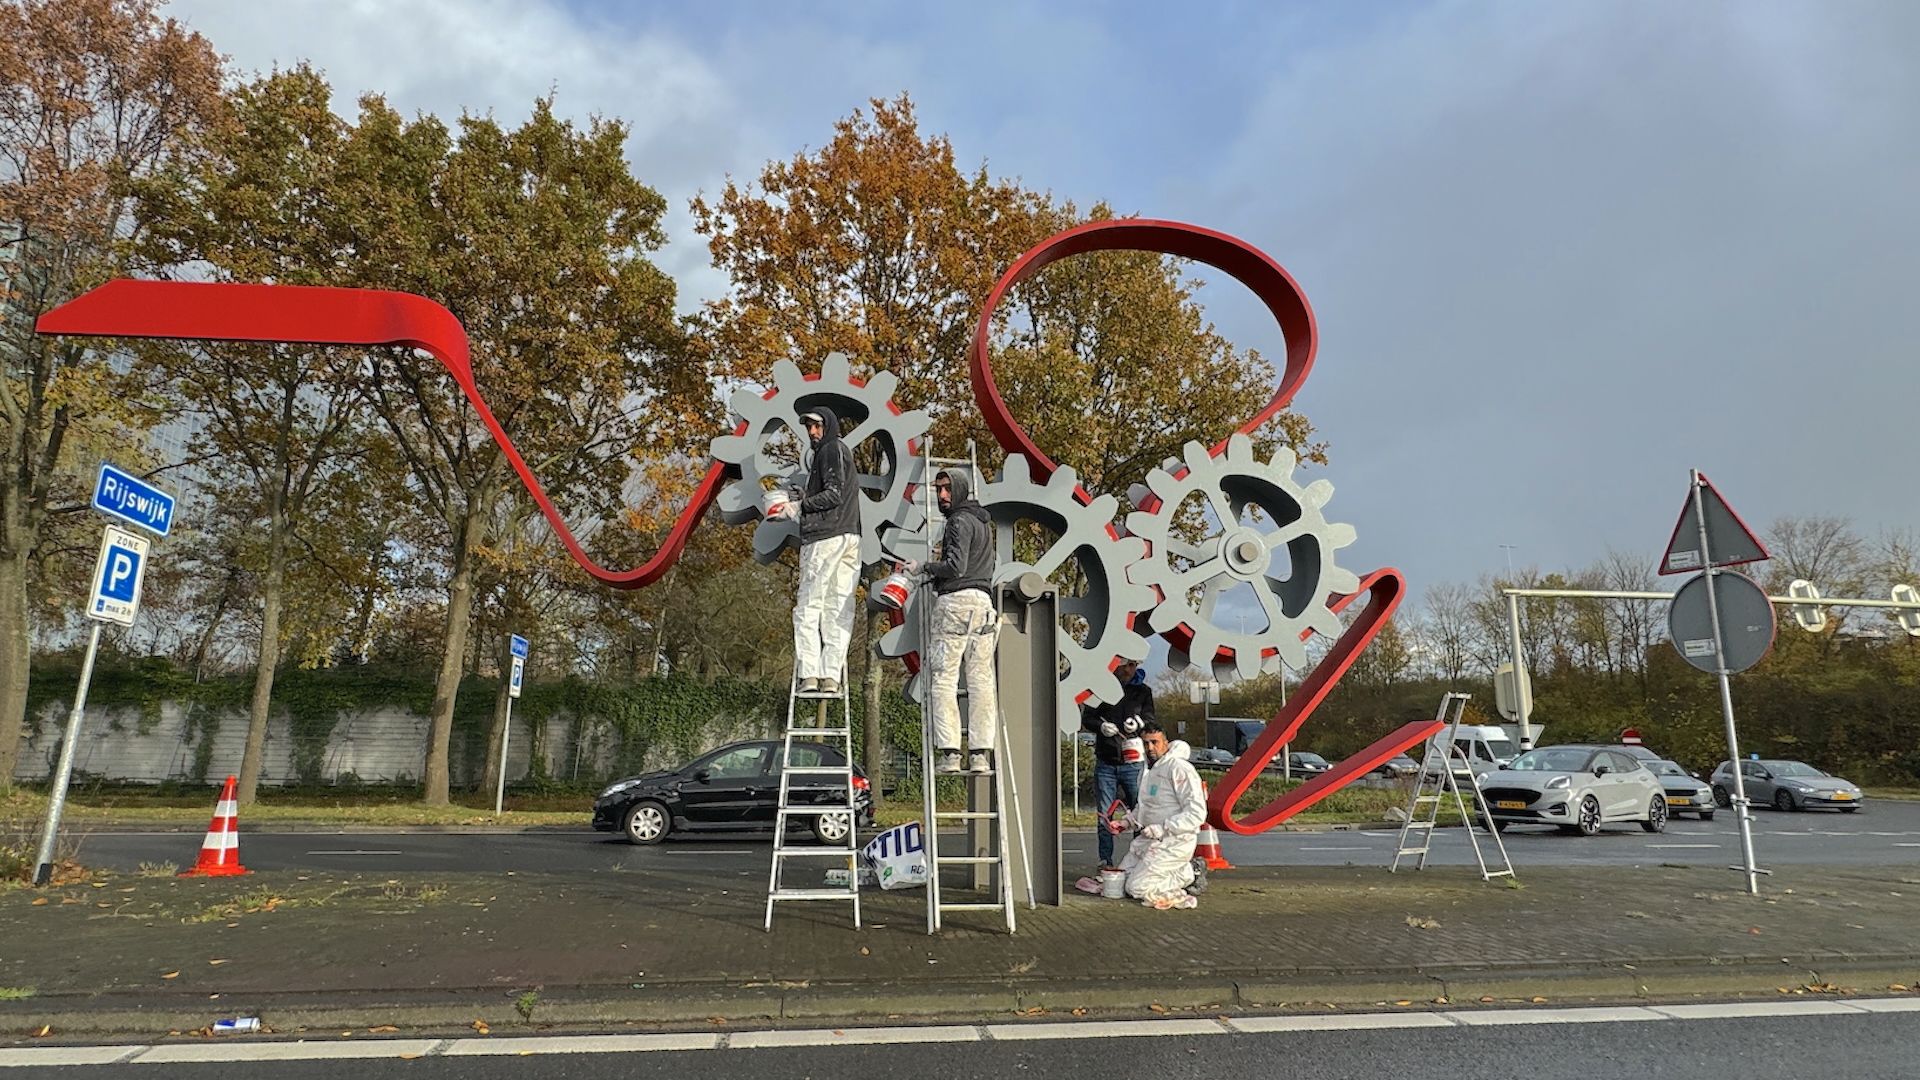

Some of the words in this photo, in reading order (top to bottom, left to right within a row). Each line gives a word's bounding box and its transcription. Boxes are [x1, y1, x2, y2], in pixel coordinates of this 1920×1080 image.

[103, 476, 167, 523] Rijswijk
[116, 535, 139, 551] ZONE
[109, 553, 132, 591] P
